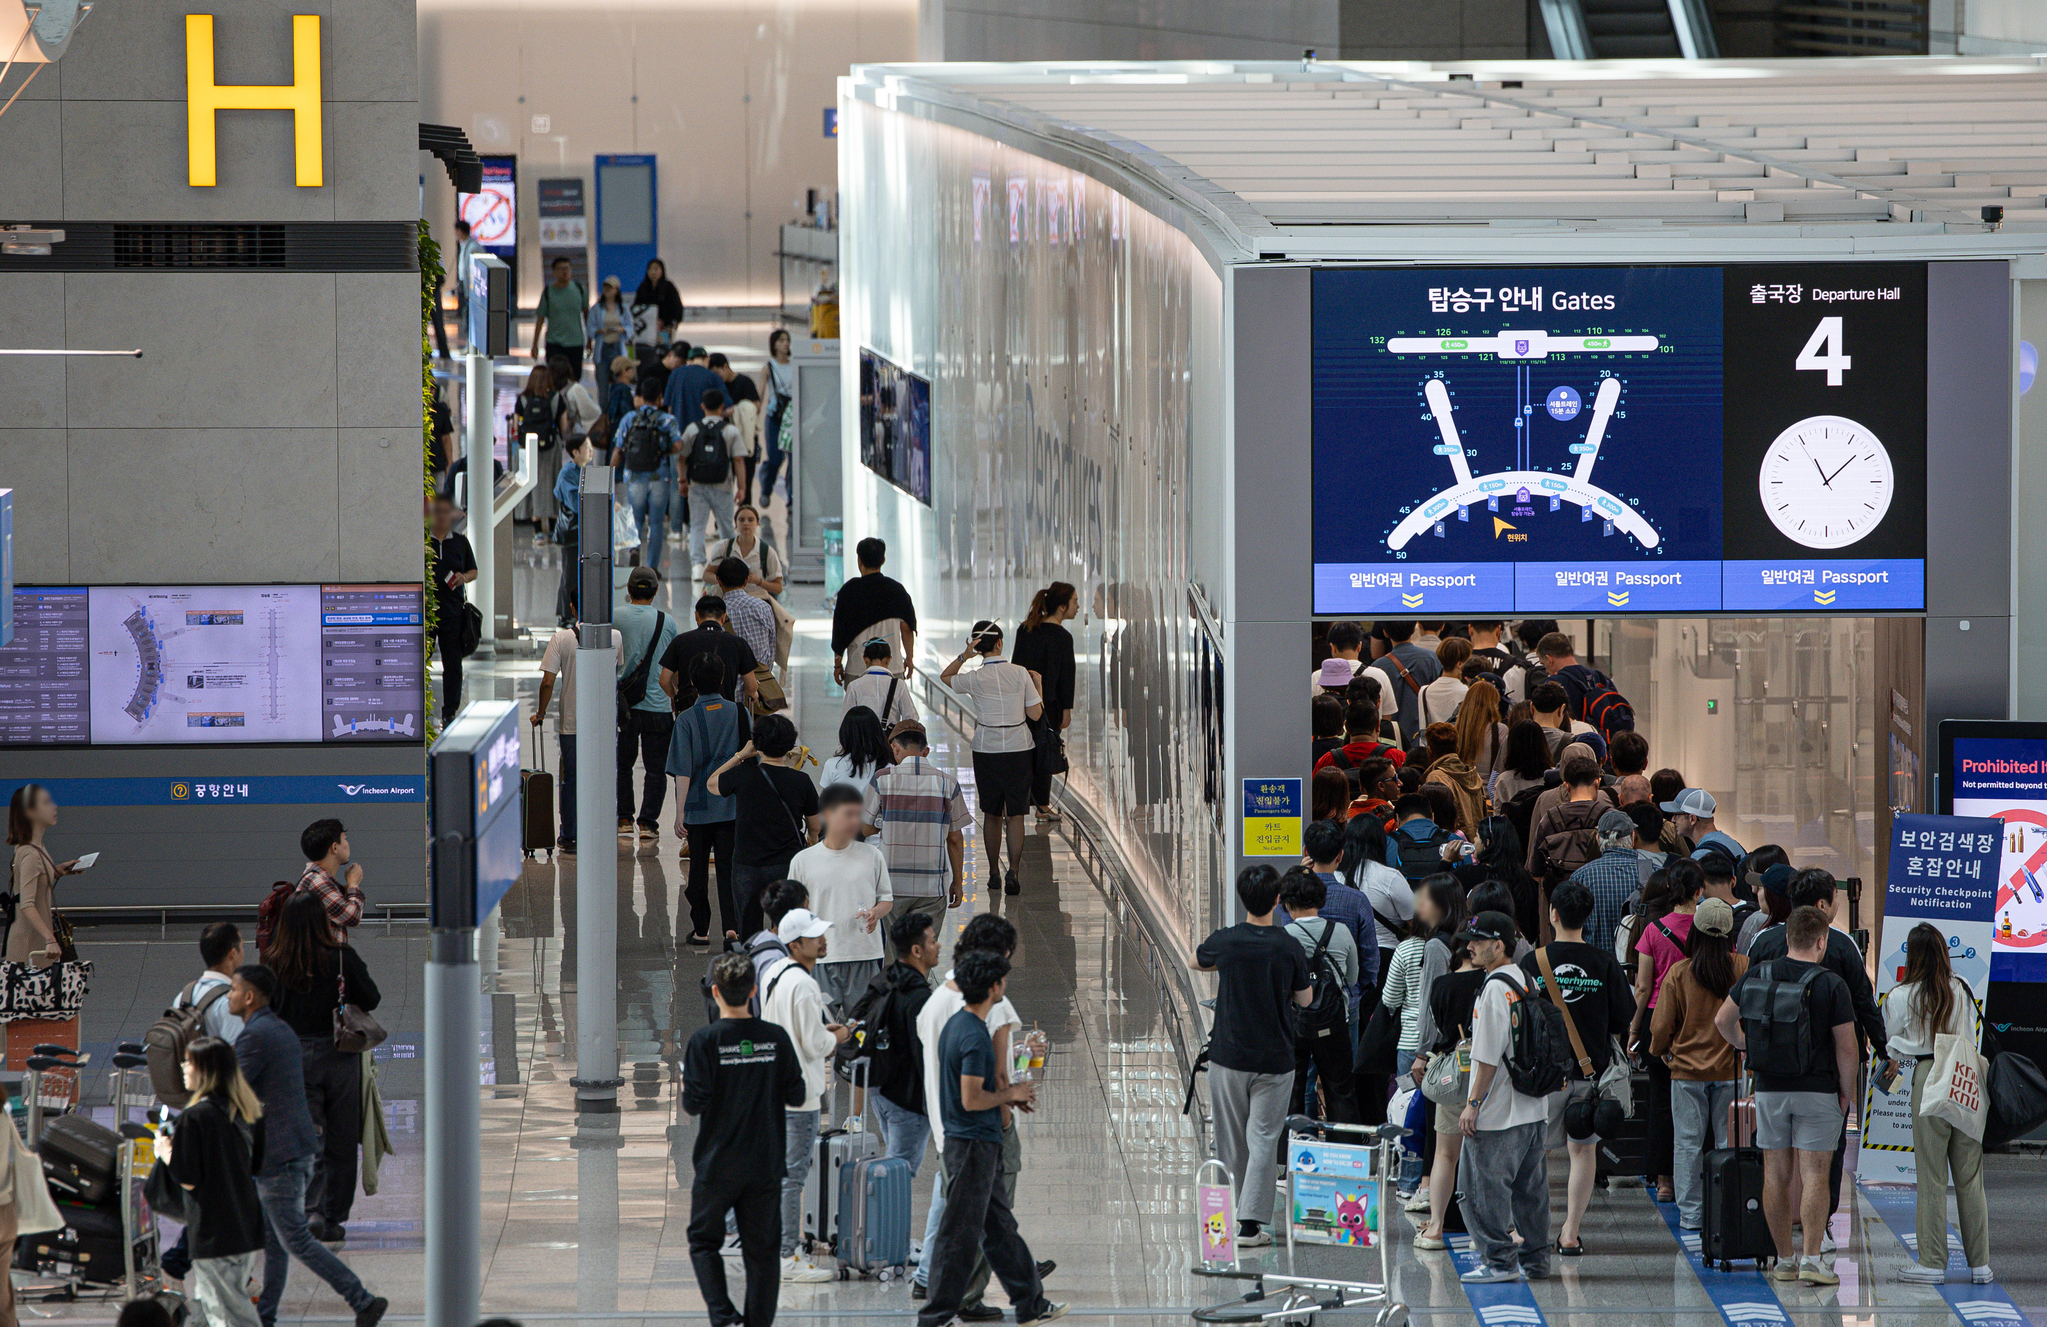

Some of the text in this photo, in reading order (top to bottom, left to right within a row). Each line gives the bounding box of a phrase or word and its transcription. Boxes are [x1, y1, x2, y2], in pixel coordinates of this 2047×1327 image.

[185, 14, 323, 187] H
[1749, 283, 1901, 304] 출국장 Departure Hall
[1427, 286, 1616, 313] 탑승구 안내 Gates
[1436, 328, 1452, 336] 126
[1586, 327, 1602, 335] 110
[1369, 336, 1385, 344] 132
[1659, 345, 1674, 353] 101
[1795, 316, 1852, 386] 4
[1478, 353, 1494, 361] 121
[1550, 353, 1566, 361] 113
[1433, 370, 1444, 378] 35
[1600, 370, 1611, 378] 20
[1420, 413, 1432, 421] 40
[1615, 411, 1626, 419] 15
[1466, 449, 1477, 457] 30
[1561, 462, 1572, 471] 25
[1490, 499, 1497, 508] 4
[1552, 499, 1558, 507] 3
[1628, 497, 1639, 506] 10
[1399, 506, 1410, 514] 45
[1460, 509, 1466, 518] 5
[1584, 509, 1590, 518] 2
[1436, 525, 1442, 533] 6
[1606, 523, 1611, 531] 1
[1507, 533, 1528, 543] 현위치
[1628, 536, 1633, 544] 1
[1657, 546, 1663, 554] 5
[1396, 551, 1407, 560] 50
[1349, 572, 1476, 589] 일반여권 Passport
[1555, 570, 1682, 588] 일반여권 Passport
[1760, 568, 1889, 587] 일반여권 Passport
[1962, 758, 2038, 774] Prohibited
[1962, 780, 1977, 788] Not
[1977, 780, 2015, 790] permitted
[2015, 781, 2043, 791] beyond
[195, 783, 249, 798] 공항안내
[362, 786, 414, 796] Incheon Airport
[1255, 796, 1291, 806] 진입불가
[1264, 822, 1282, 831] 카트
[1256, 834, 1290, 844] 진입금지
[1899, 830, 1995, 854] 보안검색장
[1906, 856, 1982, 880] 혼잡안내
[1888, 884, 1993, 900] Security Checkpoint
[1910, 897, 1972, 910] Notification
[1872, 1109, 1893, 1117] Please
